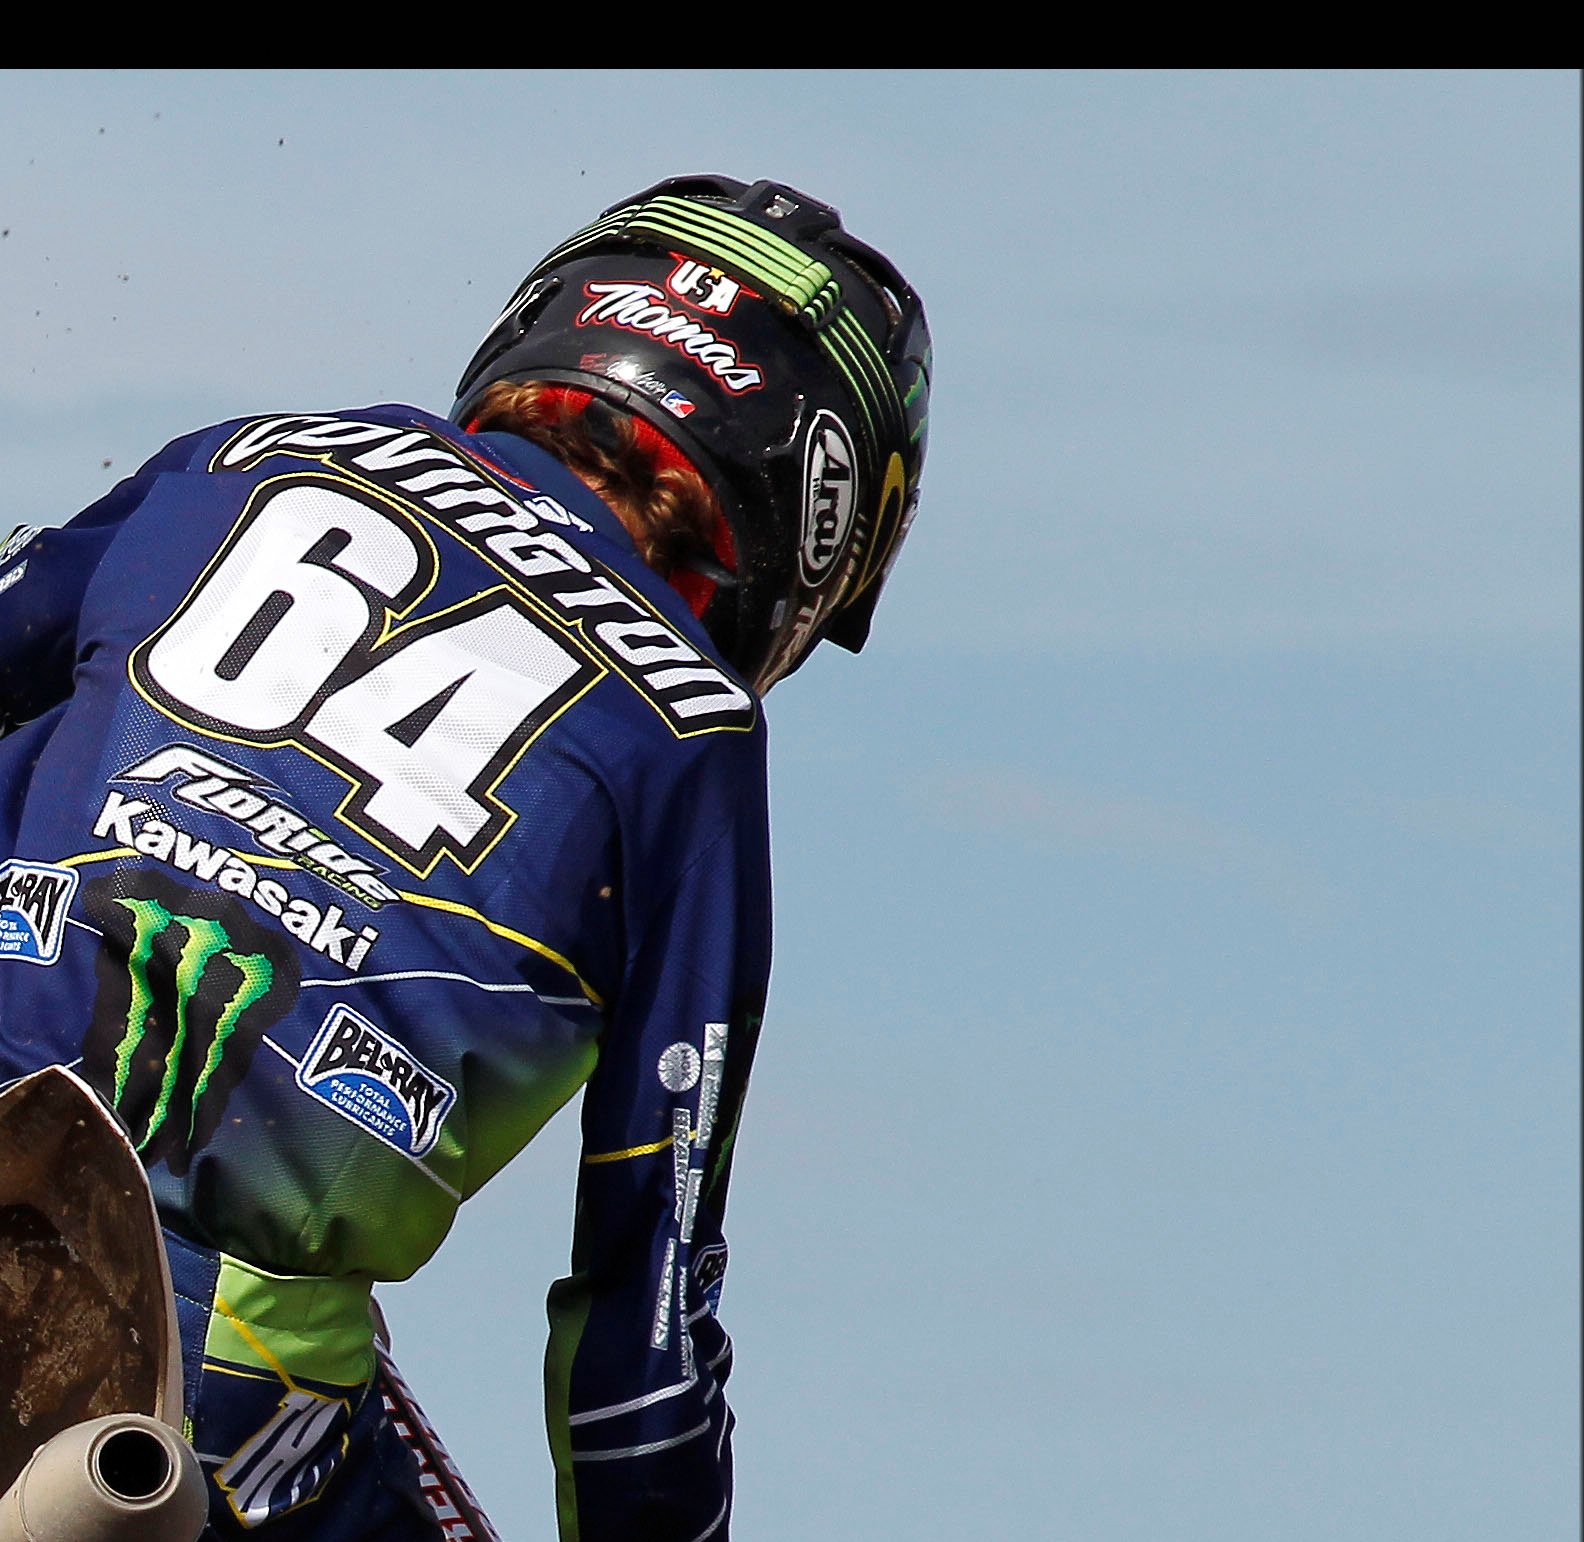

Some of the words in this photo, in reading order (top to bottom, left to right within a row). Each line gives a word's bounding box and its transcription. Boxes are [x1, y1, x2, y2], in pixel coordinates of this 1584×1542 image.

[670, 259, 740, 313] USA
[581, 282, 762, 390] Thomas
[814, 427, 850, 565] Arai
[223, 416, 751, 719] COVINGTON
[146, 484, 583, 852] 64
[92, 790, 380, 973] Kawasaki
[297, 855, 381, 909] RACING
[330, 1078, 408, 1132] PERFORMANCE
[331, 1090, 396, 1137] LUBRICANTS
[358, 1082, 392, 1109] TOTAL
